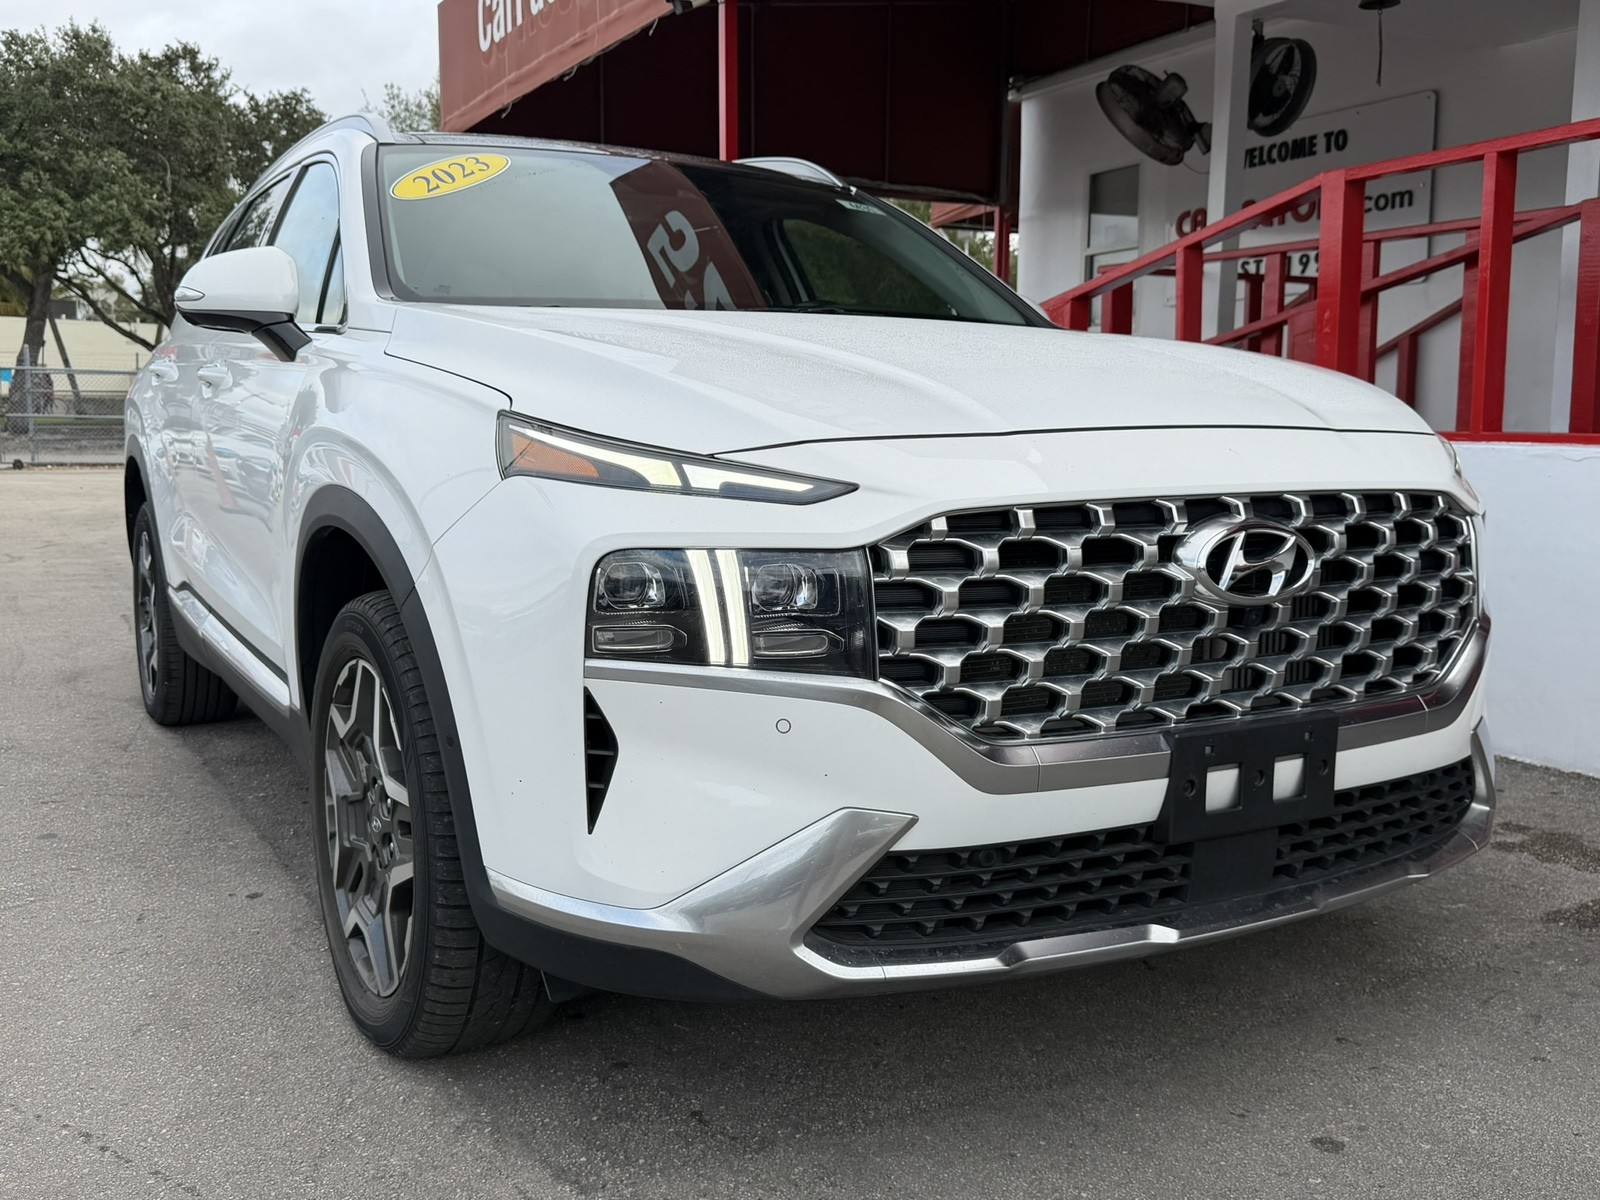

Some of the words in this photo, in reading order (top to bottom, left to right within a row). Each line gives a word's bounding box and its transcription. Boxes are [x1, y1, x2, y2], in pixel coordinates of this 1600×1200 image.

[1244, 135, 1318, 169] ELCOME
[1323, 129, 1349, 153] TO
[412, 156, 490, 193] 2023
